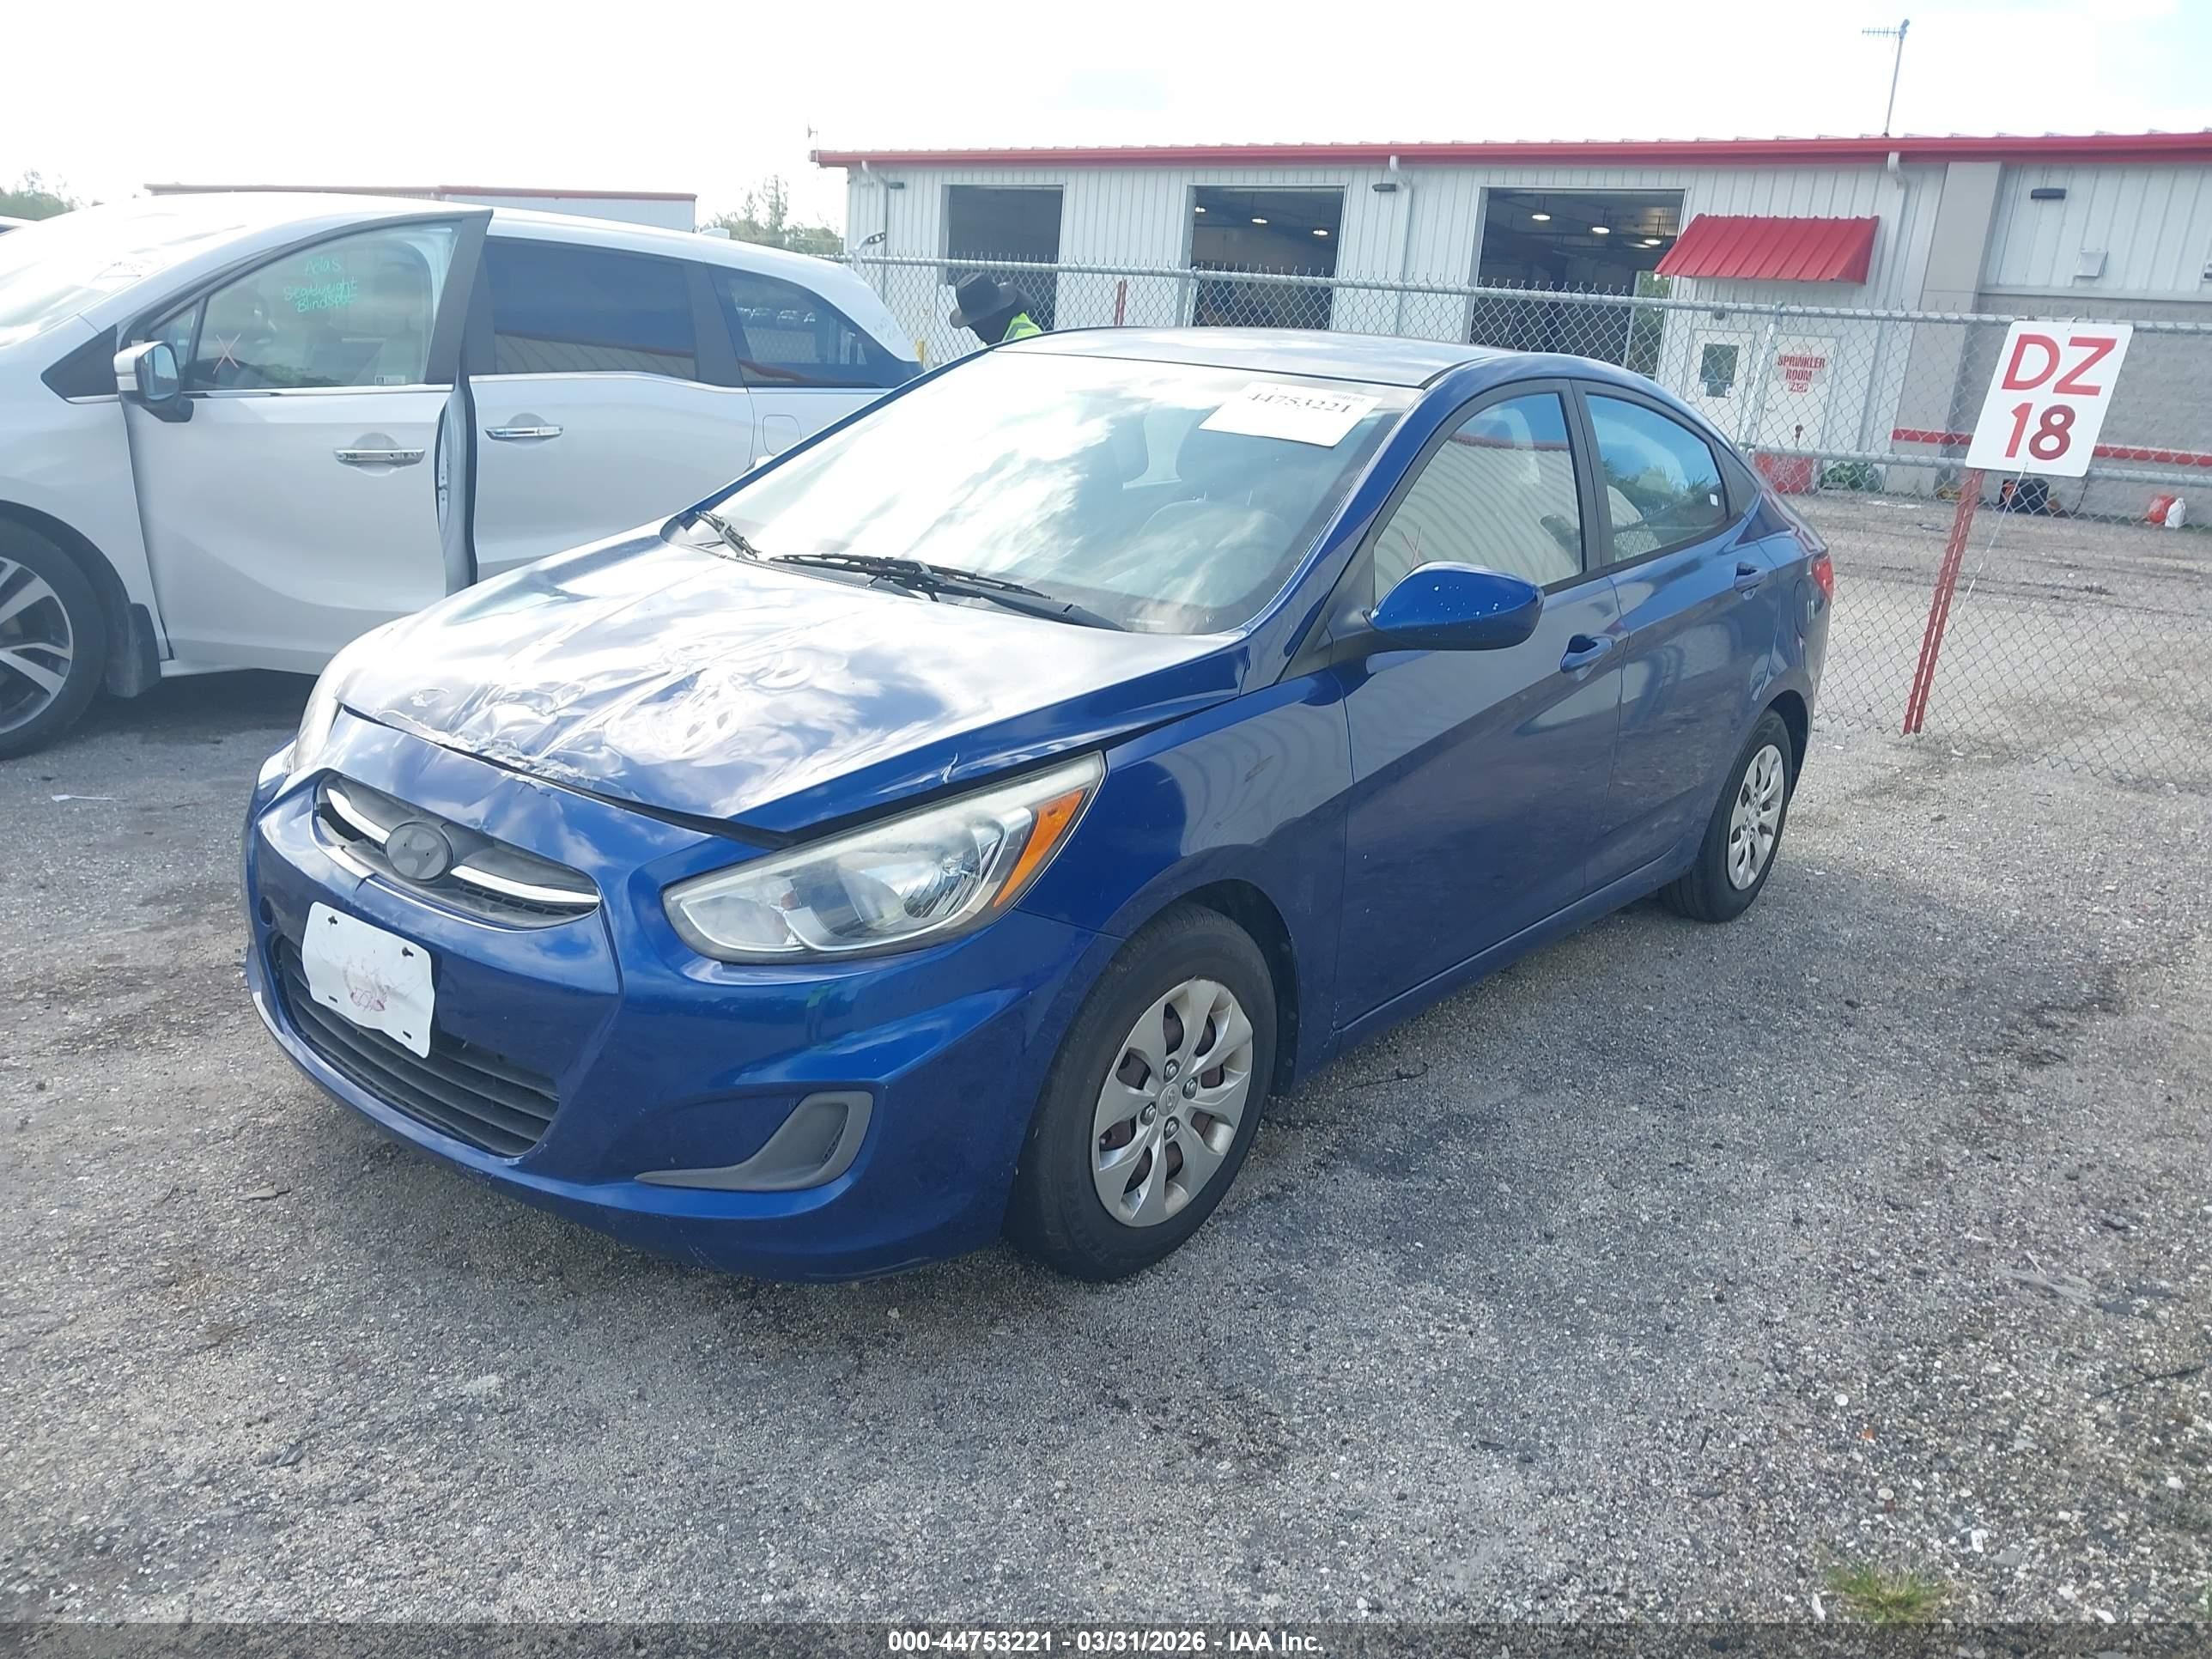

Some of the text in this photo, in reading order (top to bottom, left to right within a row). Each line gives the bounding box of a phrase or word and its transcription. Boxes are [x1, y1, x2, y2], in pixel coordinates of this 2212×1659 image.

[1778, 355, 1826, 369] SPRINKLER
[1786, 369, 1813, 382] ROOM
[2002, 334, 2118, 396] DZ
[2005, 403, 2076, 460] 18
